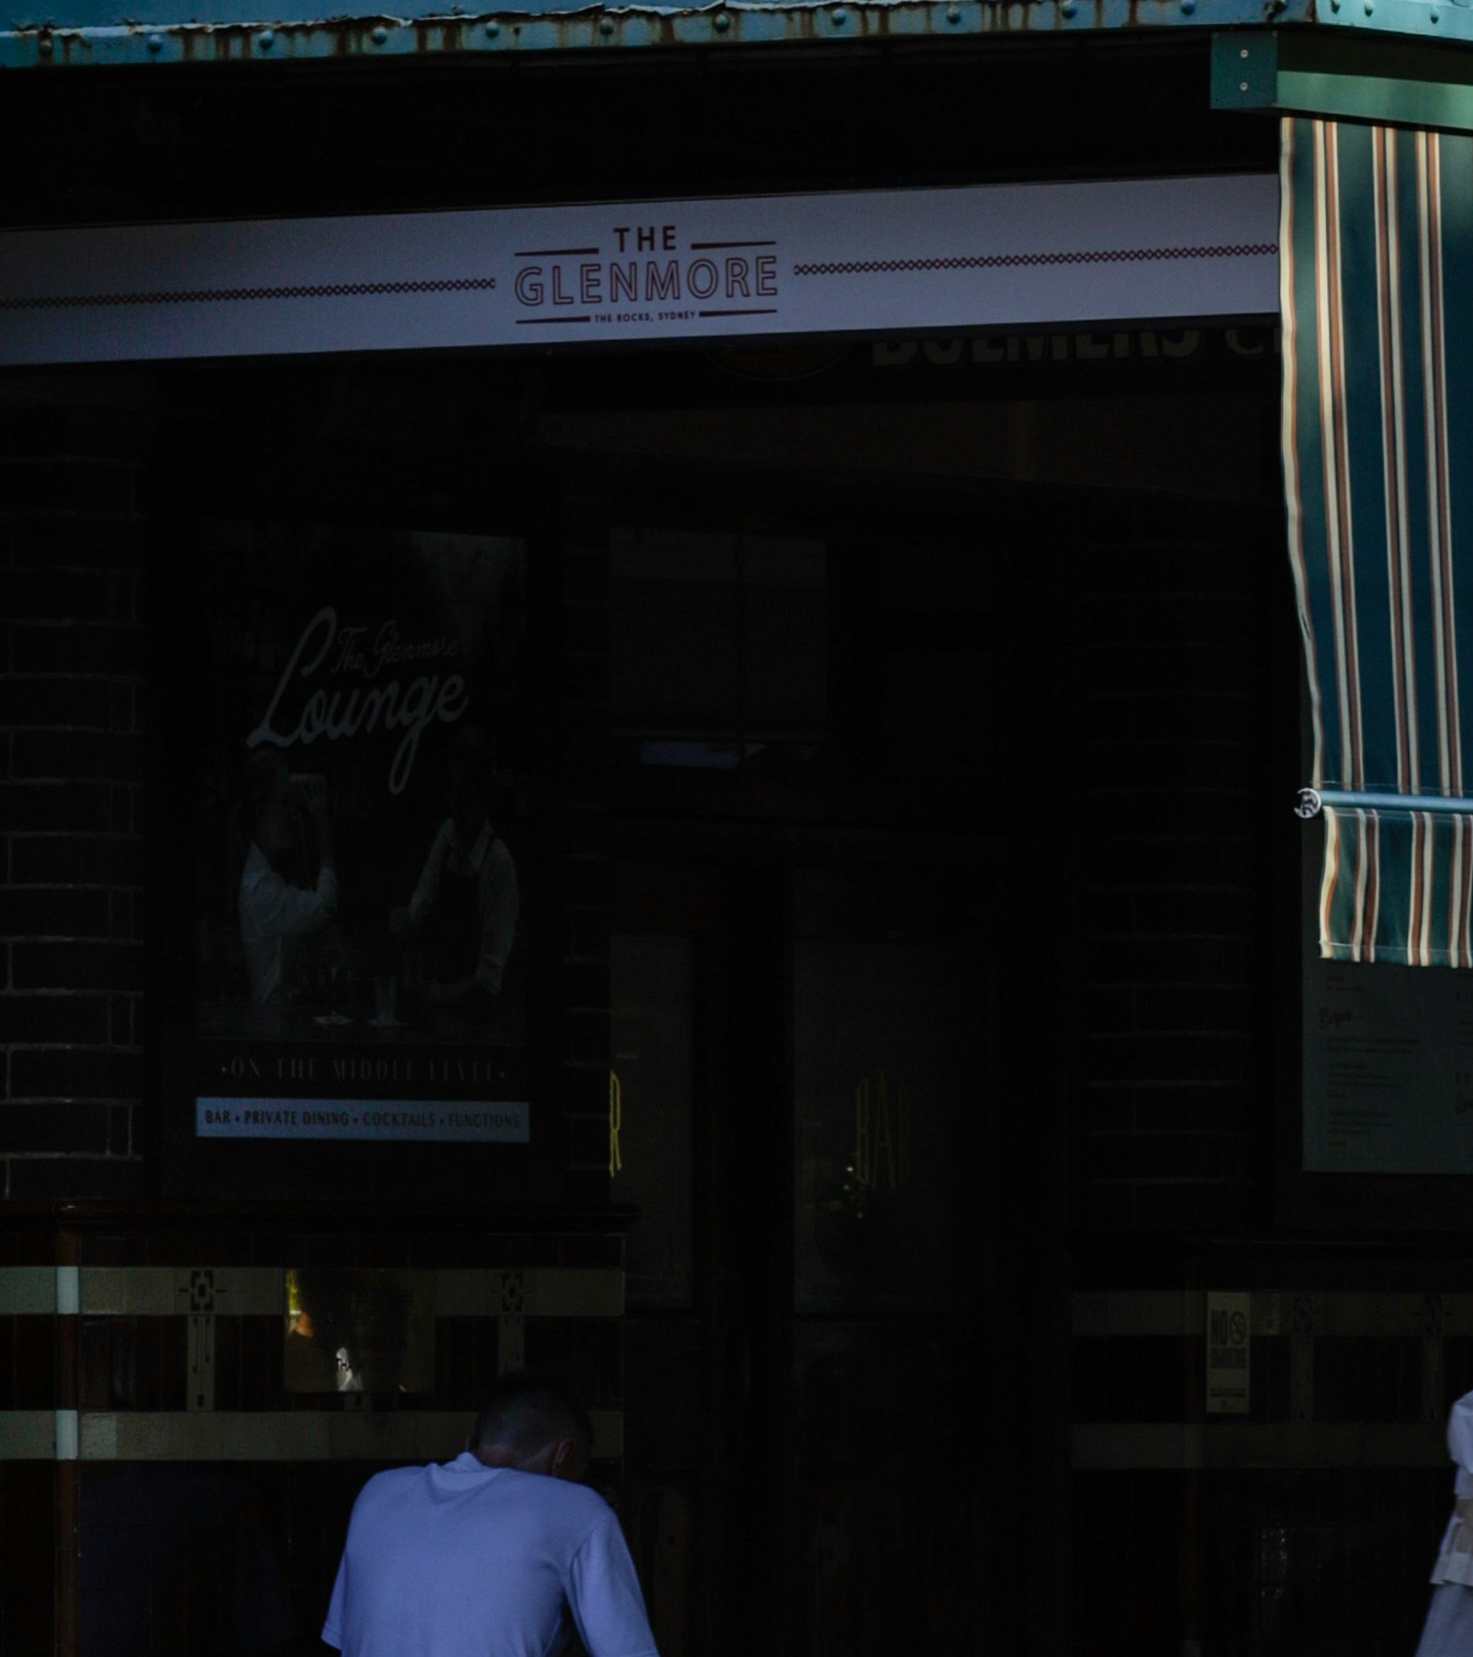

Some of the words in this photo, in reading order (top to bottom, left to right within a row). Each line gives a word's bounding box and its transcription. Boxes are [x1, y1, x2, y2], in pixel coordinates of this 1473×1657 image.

[613, 225, 677, 252] THE
[514, 255, 778, 307] GLENMORE
[594, 314, 613, 323] THE
[616, 311, 653, 323] ROCKS,
[658, 309, 696, 321] SYDNEY
[330, 626, 369, 674] The
[246, 605, 470, 797] Lounge
[276, 1056, 318, 1081] THE
[331, 1057, 417, 1082] MIDDLE
[205, 1110, 231, 1124] BAR
[244, 1110, 298, 1126] PRIVATE
[302, 1111, 349, 1126] DINING
[362, 1111, 436, 1127] COCKTAILS
[448, 1112, 521, 1129] FUNCTIONS
